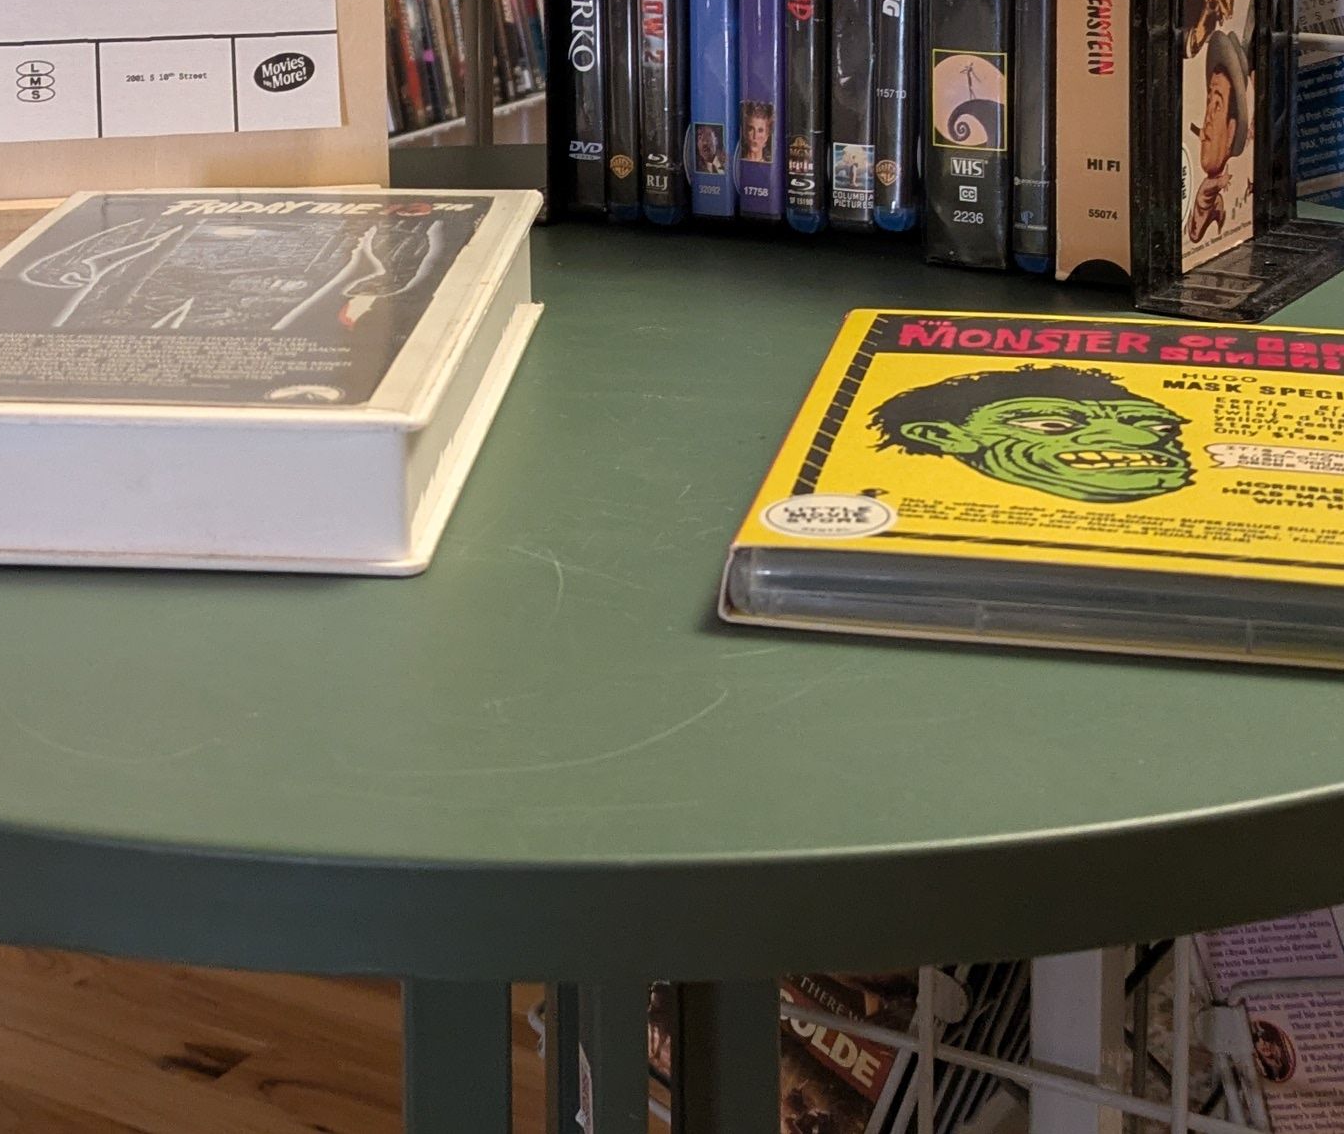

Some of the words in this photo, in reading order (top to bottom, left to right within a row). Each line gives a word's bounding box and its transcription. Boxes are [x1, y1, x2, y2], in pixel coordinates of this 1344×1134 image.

[30, 63, 40, 73] L
[262, 56, 305, 77] Movies
[30, 77, 41, 86] M
[179, 72, 208, 81] Street
[270, 66, 308, 89] More!
[31, 90, 40, 100] S
[569, 140, 603, 154] DVD
[952, 158, 985, 176] VHS
[1087, 158, 1104, 171] HI
[1106, 159, 1121, 173] FI
[646, 174, 668, 189] RLJ
[743, 186, 769, 197] 17758
[833, 190, 874, 200] COLUMBIA
[162, 199, 312, 216] FRIDAY
[308, 202, 383, 215] THE
[834, 199, 874, 209] PICTURES
[952, 210, 984, 225] 2236
[1088, 207, 1118, 221] 55074
[899, 323, 1150, 355] MONSTER
[1181, 372, 1258, 383] HUGO
[1163, 379, 1242, 394] MASK
[1222, 486, 1283, 498] HEAD
[1236, 480, 1344, 494] HORRIBLE
[1252, 497, 1315, 508] WITH
